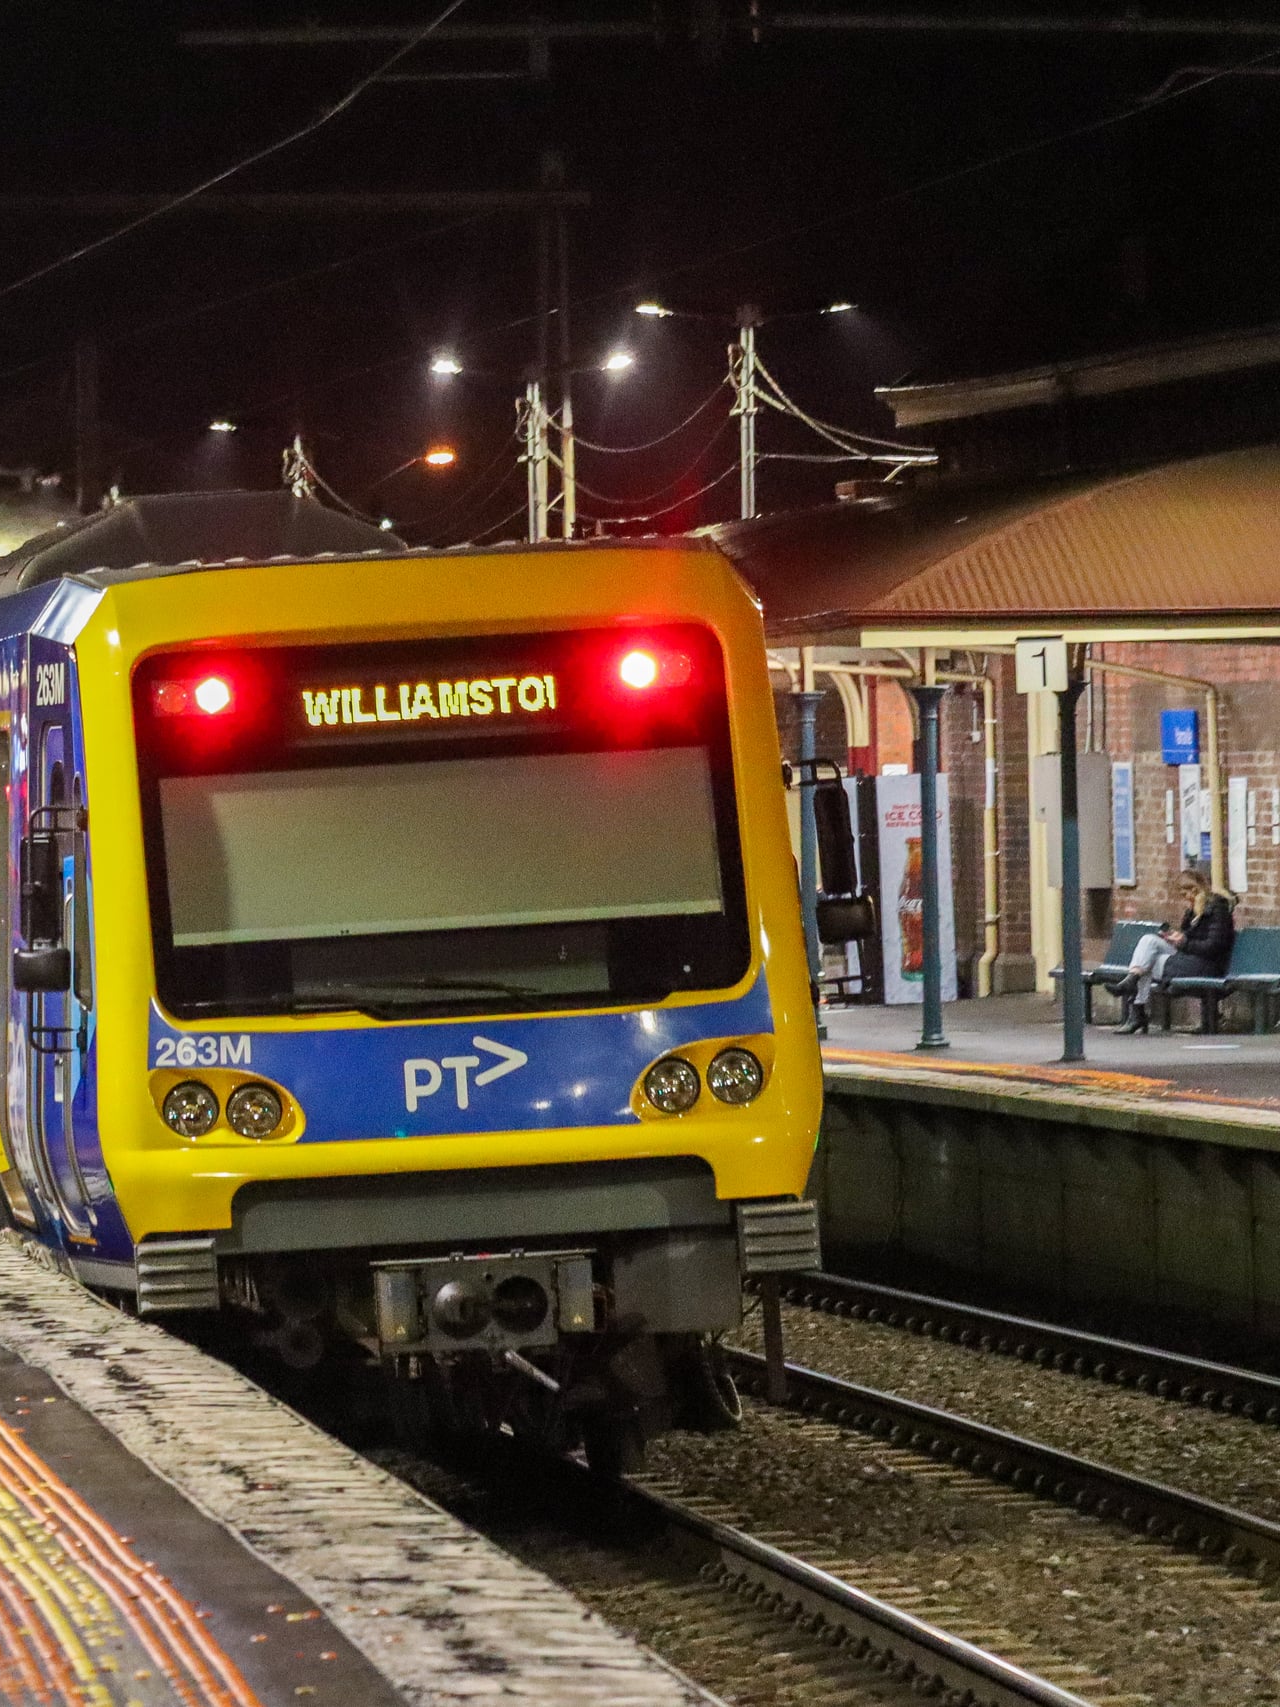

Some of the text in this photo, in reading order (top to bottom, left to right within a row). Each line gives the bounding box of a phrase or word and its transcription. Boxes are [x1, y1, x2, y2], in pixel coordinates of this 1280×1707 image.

[36, 662, 65, 706] 263M
[1031, 647, 1047, 687] 1
[155, 1034, 252, 1067] 263M
